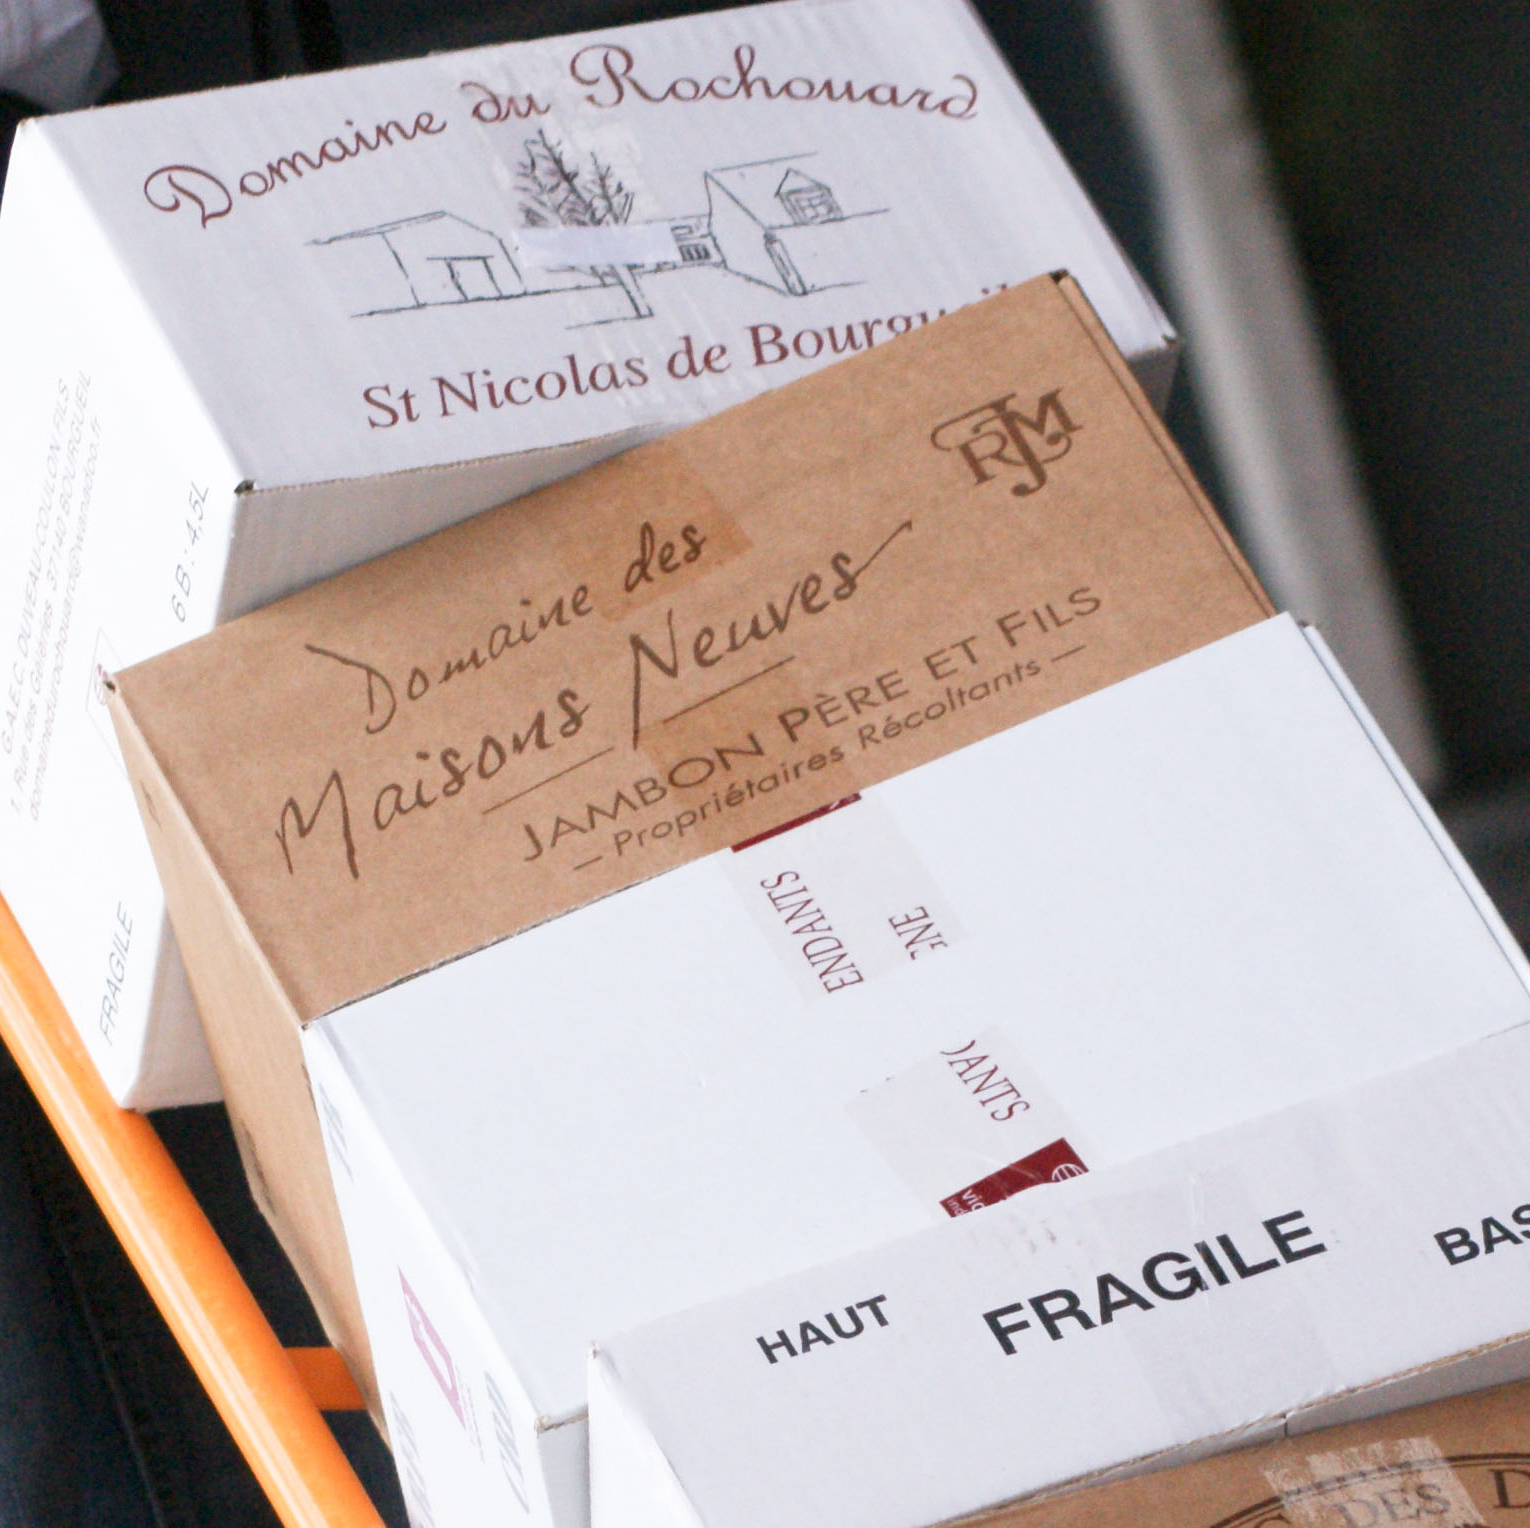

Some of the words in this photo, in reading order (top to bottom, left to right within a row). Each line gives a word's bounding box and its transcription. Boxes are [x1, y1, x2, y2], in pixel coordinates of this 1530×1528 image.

[144, 109, 447, 229] Domaine
[461, 81, 551, 123] du
[570, 43, 979, 120] Rochouard
[59, 369, 91, 516] BOURGUEIL
[362, 384, 420, 429] St
[431, 353, 648, 417] Nicolas
[666, 335, 732, 379] de
[273, 685, 595, 879] Maisons
[628, 518, 914, 750] Neuves
[305, 583, 594, 734] Domaine
[623, 521, 707, 595] des
[522, 732, 766, 862] JAMBON
[778, 670, 911, 743] PÈRE
[923, 635, 980, 680] ET
[995, 586, 1102, 648] FILS
[612, 744, 845, 857] Propriétaires
[858, 656, 1042, 750] Récoltants
[99, 901, 134, 1046] FRAGILE
[759, 869, 864, 993] ENDANTS
[755, 1293, 893, 1365] HAUT
[981, 1209, 1329, 1357] FRAGILE
